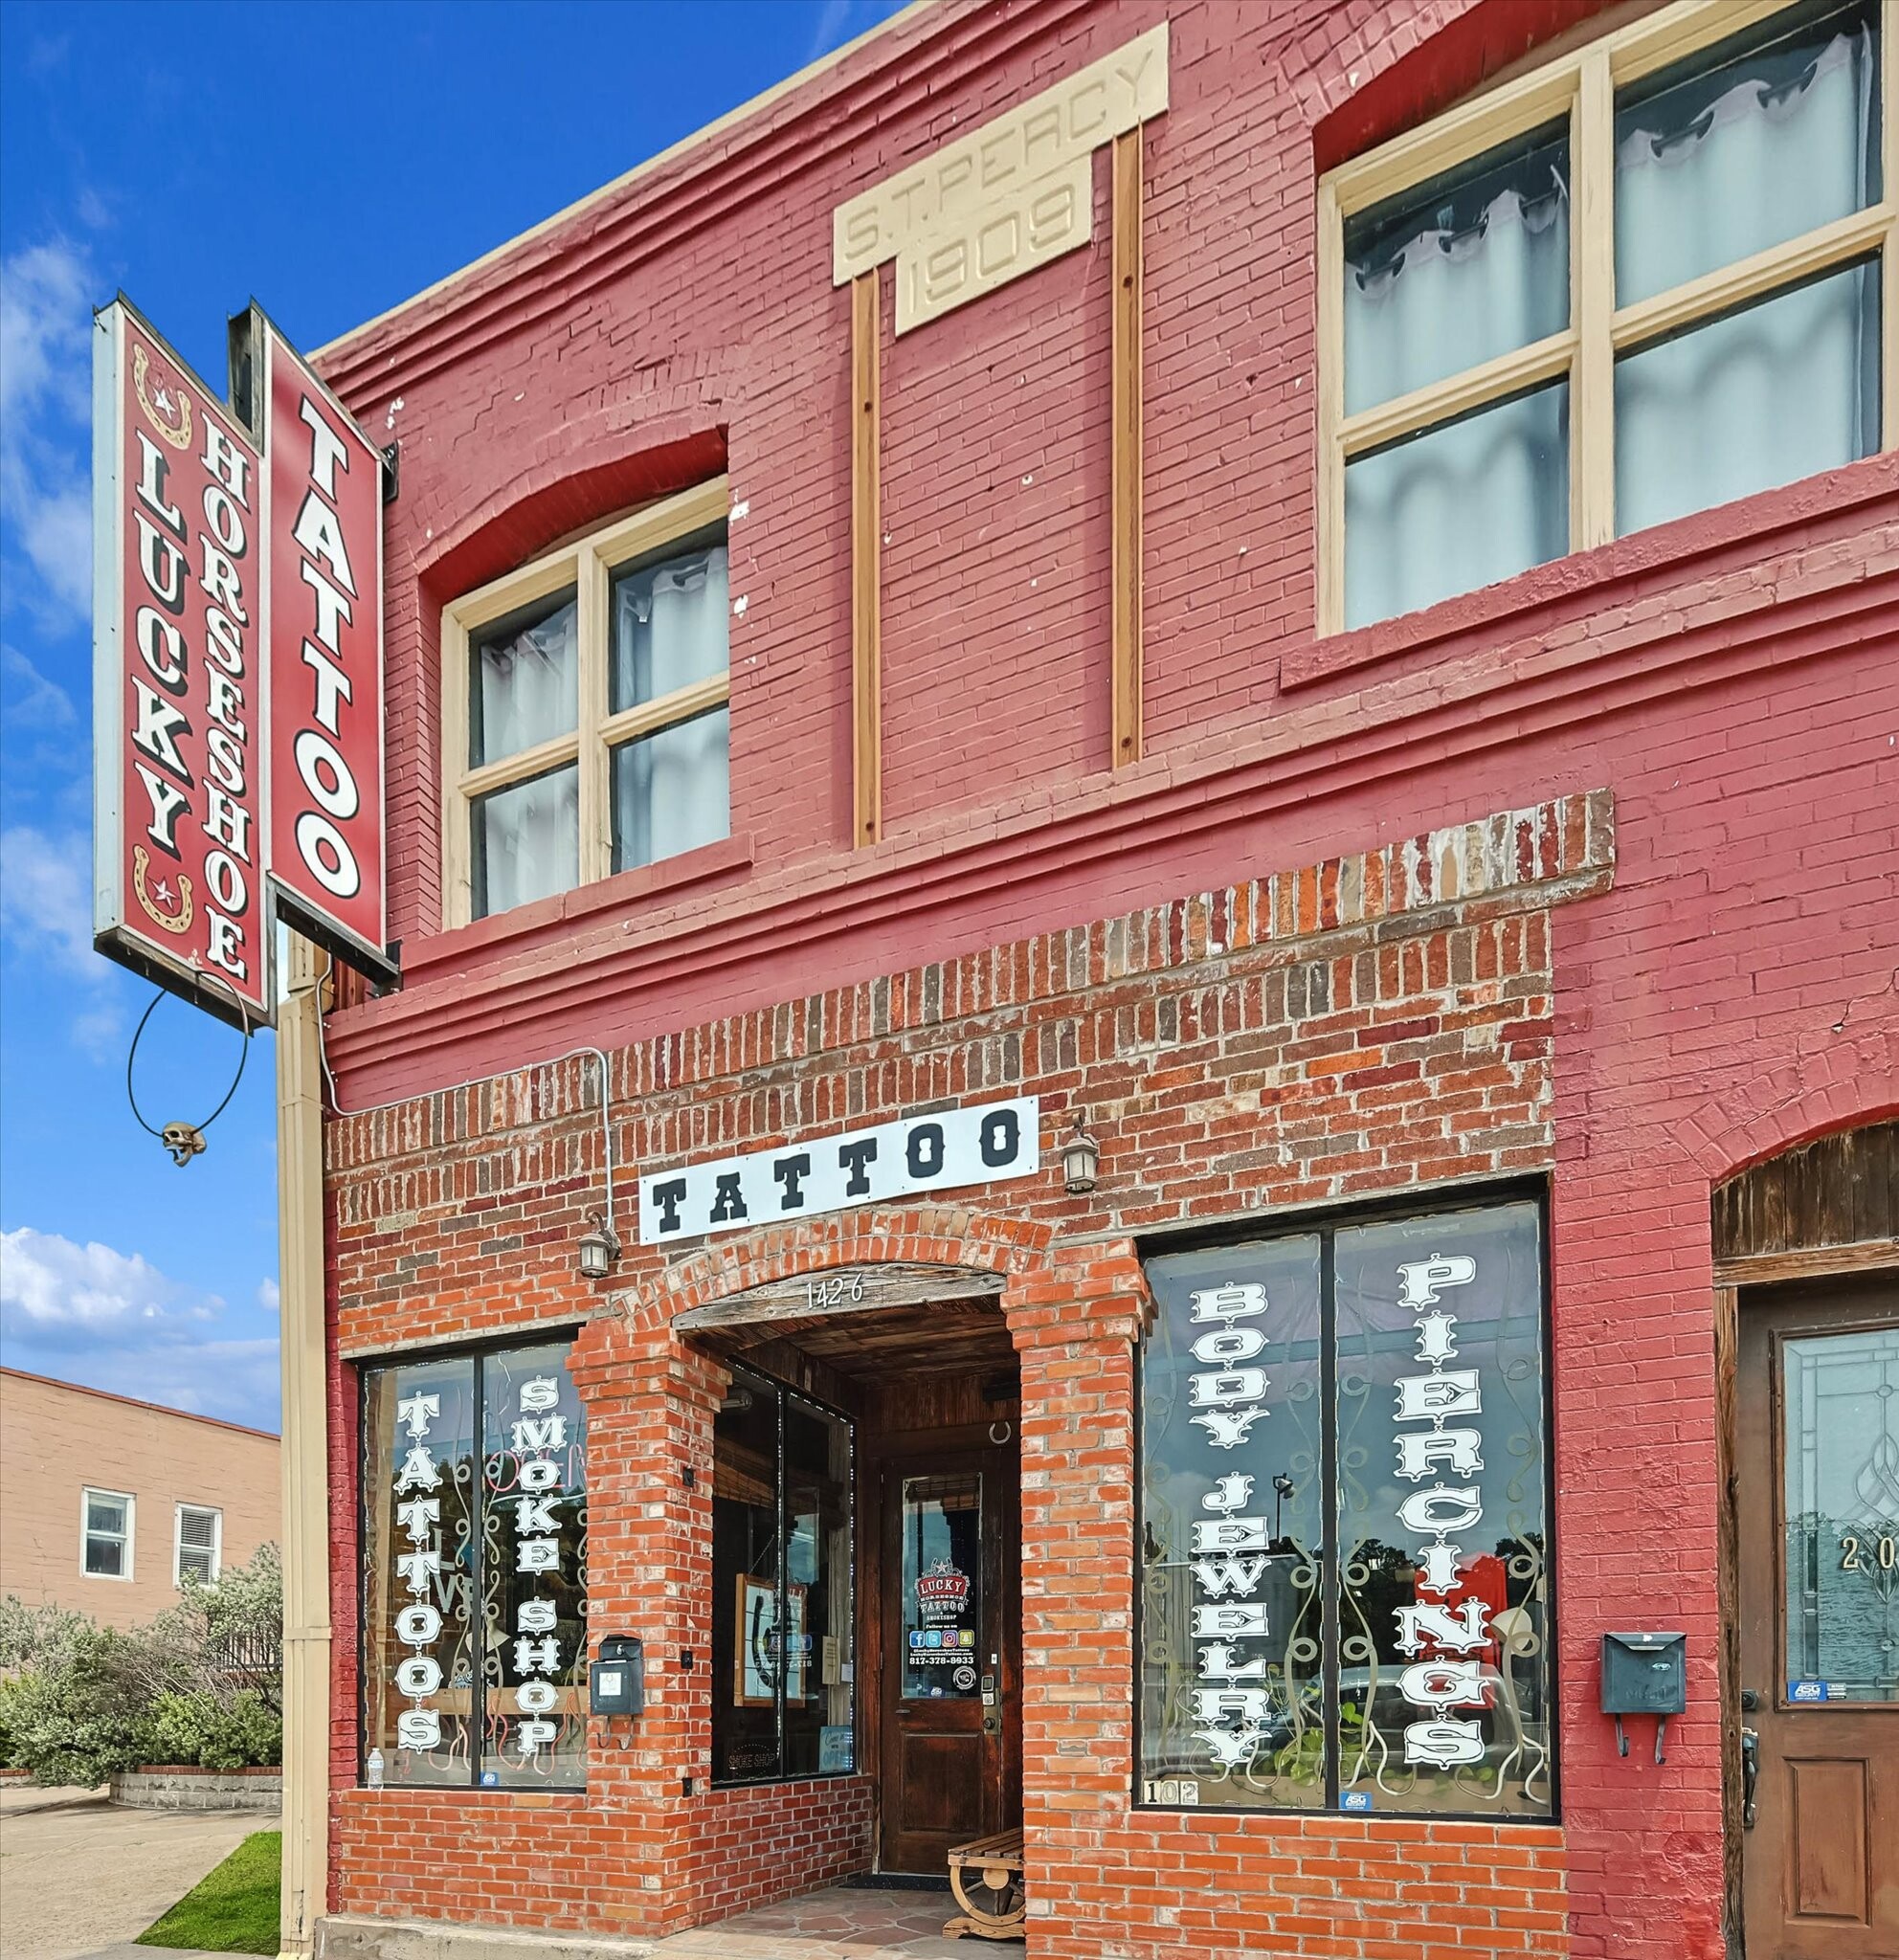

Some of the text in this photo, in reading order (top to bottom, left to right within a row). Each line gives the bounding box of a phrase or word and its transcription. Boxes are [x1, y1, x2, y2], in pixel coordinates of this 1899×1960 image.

[908, 183, 1075, 314] 1909
[131, 428, 193, 860] LUCKY
[198, 409, 252, 984] HORSESHOE
[292, 392, 360, 900] TATTOO
[653, 1108, 1021, 1233] TATTOO
[806, 1273, 862, 1309] 1426
[393, 1391, 444, 1755] TATTOOS
[511, 1375, 569, 1756] SMOKE SHOP
[1189, 1281, 1272, 1767] BODY JEWELRY
[1392, 1253, 1494, 1771] PIERCINGS
[920, 1579, 963, 1594] LUCKY
[921, 1601, 965, 1614] TATTOO
[1796, 1684, 1821, 1694] ASG
[1148, 1782, 1196, 1804] 102
[1346, 1794, 1367, 1804] ASG
